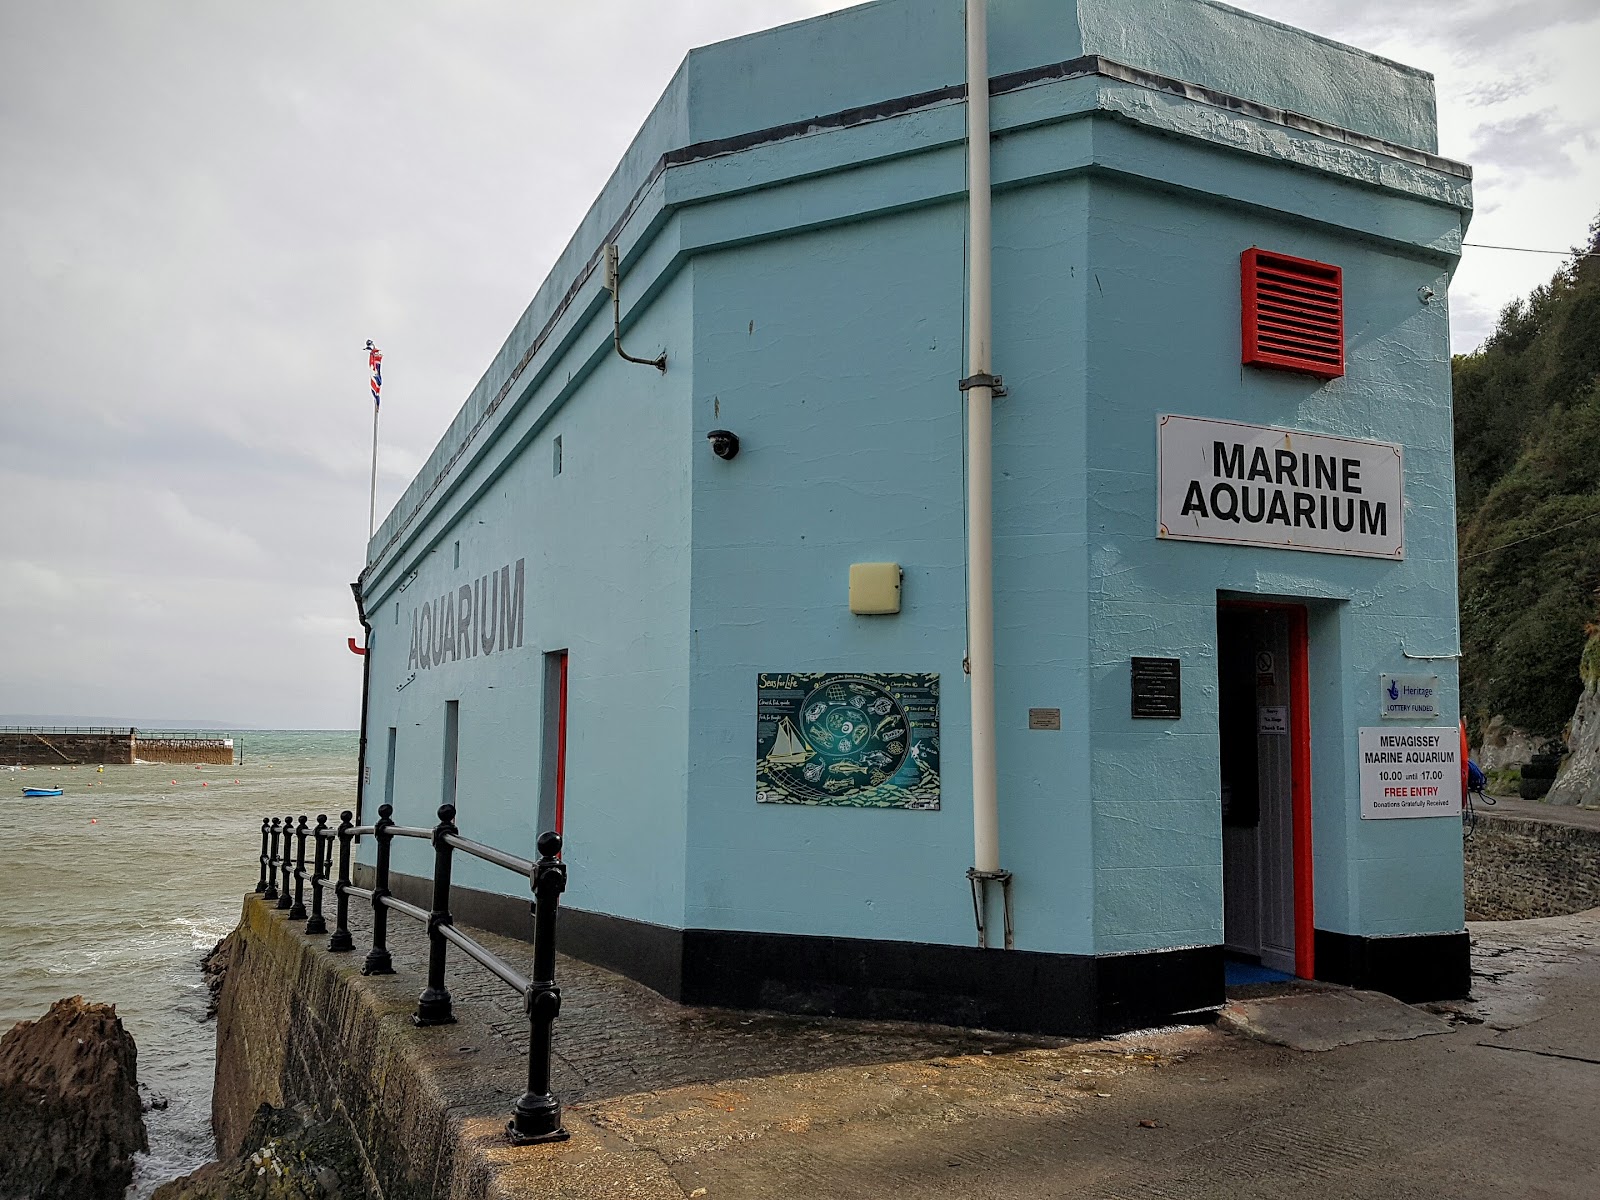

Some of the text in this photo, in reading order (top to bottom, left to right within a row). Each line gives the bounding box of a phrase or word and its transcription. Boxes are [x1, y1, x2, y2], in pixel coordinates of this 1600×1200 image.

[1213, 440, 1362, 494] MARINE
[1180, 480, 1387, 537] AQUARIUM
[407, 557, 525, 670] AQUARIUM
[759, 673, 776, 688] Seas
[785, 674, 798, 690] Life
[1403, 685, 1433, 698] Heritage
[1387, 704, 1434, 712] LOTTERY FUNDED
[1380, 735, 1440, 747] MEVAGISSEY
[1364, 751, 1455, 764] MARINE AQUARIUM
[1379, 770, 1443, 781] 10.00 until 17.00
[1384, 786, 1439, 797] FREE ENTRY
[1401, 800, 1425, 808] Gratefully
[1426, 799, 1449, 807] Received
